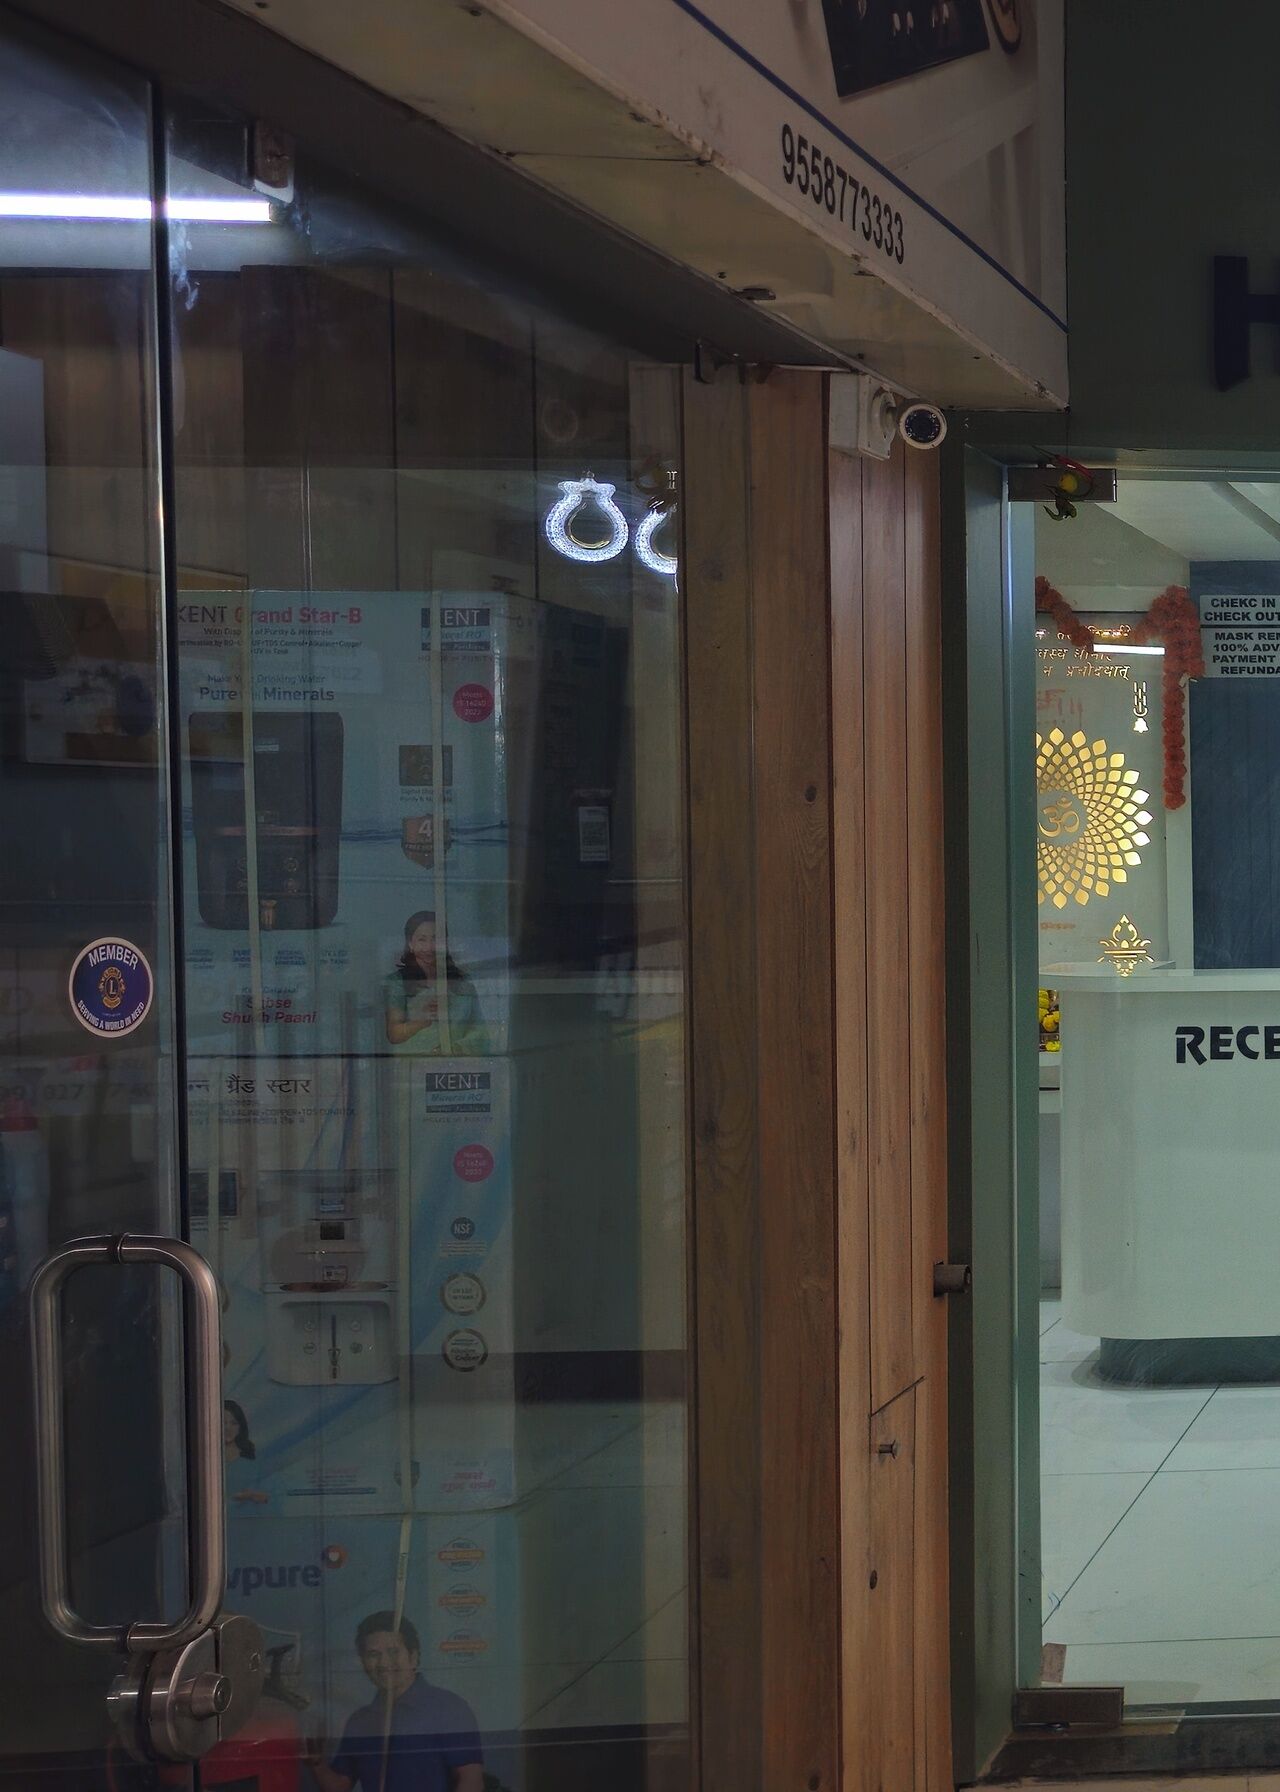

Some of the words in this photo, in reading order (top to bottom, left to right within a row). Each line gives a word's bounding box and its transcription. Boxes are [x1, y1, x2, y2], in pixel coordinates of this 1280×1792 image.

[782, 123, 905, 265] 9558773333
[1210, 598, 1258, 608] CHEKC
[1261, 598, 1276, 608] IN
[299, 606, 363, 624] Star-B
[1203, 611, 1252, 622] CHECK
[1214, 632, 1255, 641] MASK
[1213, 643, 1249, 652] 100%
[1212, 655, 1276, 663] PAYMENT
[199, 687, 238, 701] Pure
[263, 686, 336, 701] Minerals
[88, 945, 139, 971] MEMBER
[104, 1021, 125, 1031] WORLD
[131, 1001, 145, 1021] NEED
[274, 1012, 317, 1024] Paani
[224, 1074, 257, 1094] ग्रैंड
[265, 1079, 313, 1094] स्टार
[434, 1074, 481, 1090] KENT
[454, 1223, 472, 1234] NSF
